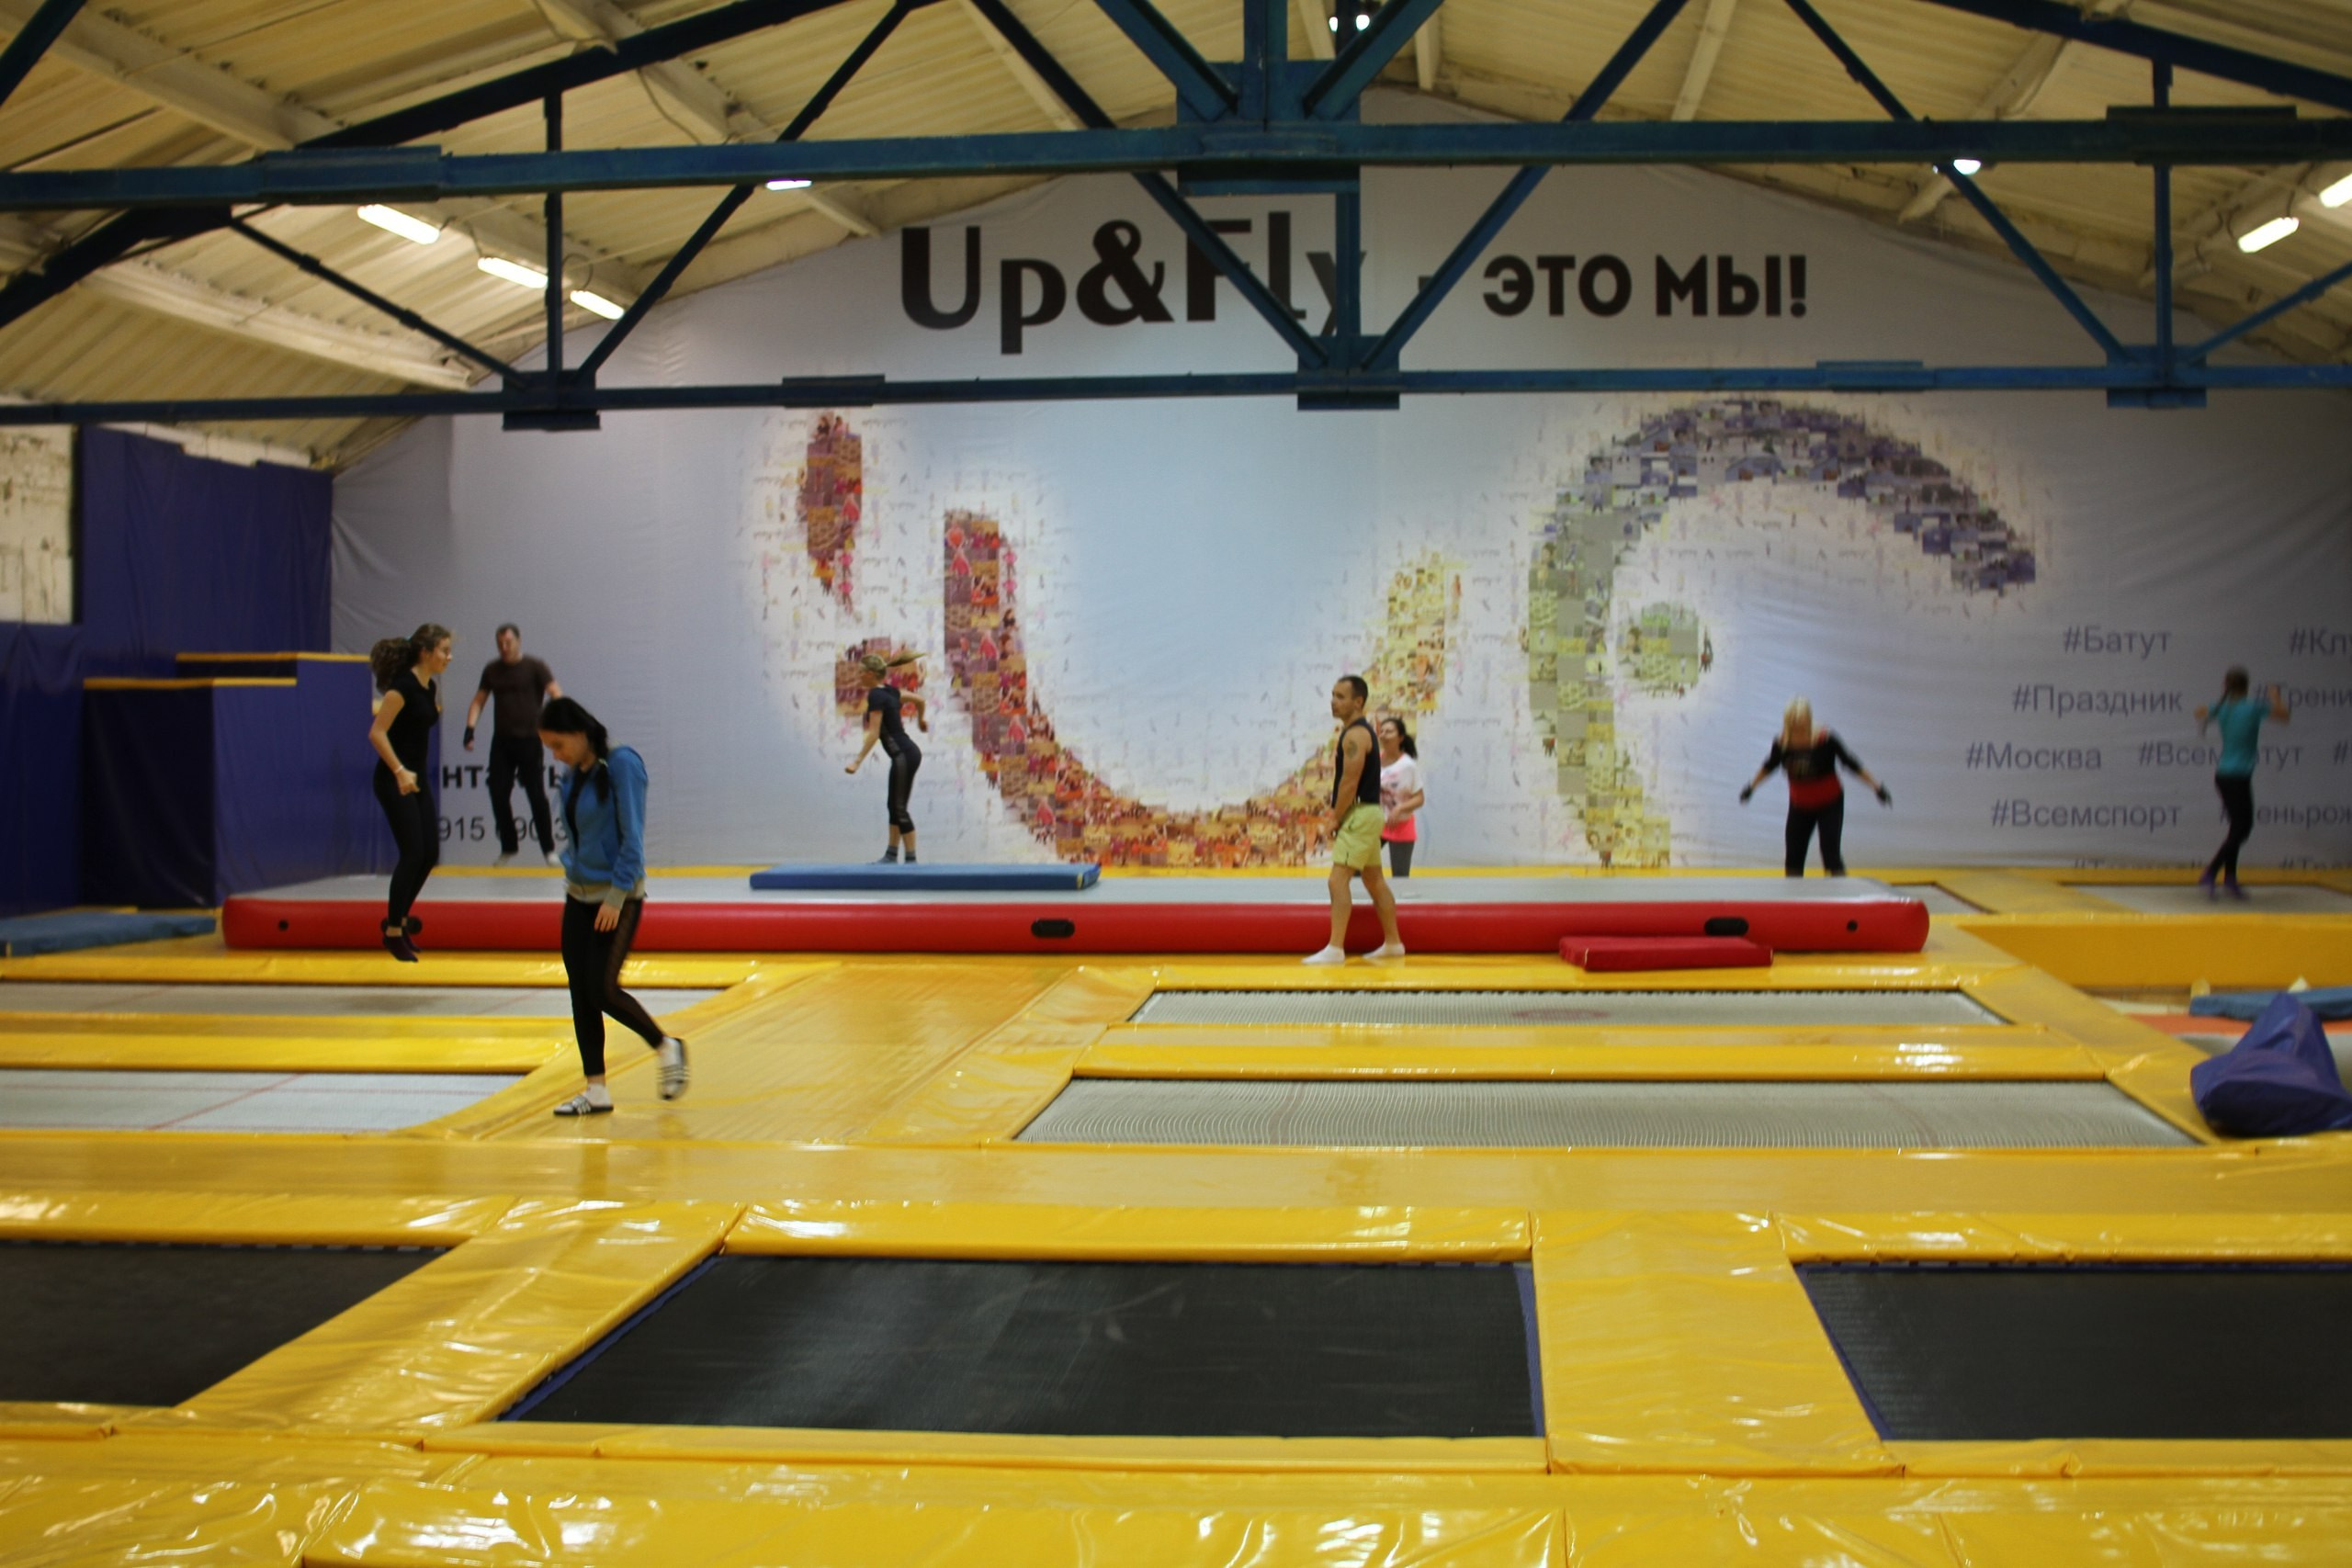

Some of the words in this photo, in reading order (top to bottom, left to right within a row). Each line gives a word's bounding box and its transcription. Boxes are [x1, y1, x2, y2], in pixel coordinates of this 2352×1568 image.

[901, 211, 1367, 355] Up&Fly
[2064, 625, 2172, 660] #Батут
[2012, 684, 2183, 718] #Праздник
[1966, 742, 2102, 770] #Москва
[2140, 741, 2304, 771] #Всемтут
[1991, 798, 2181, 833] #Всемспорт
